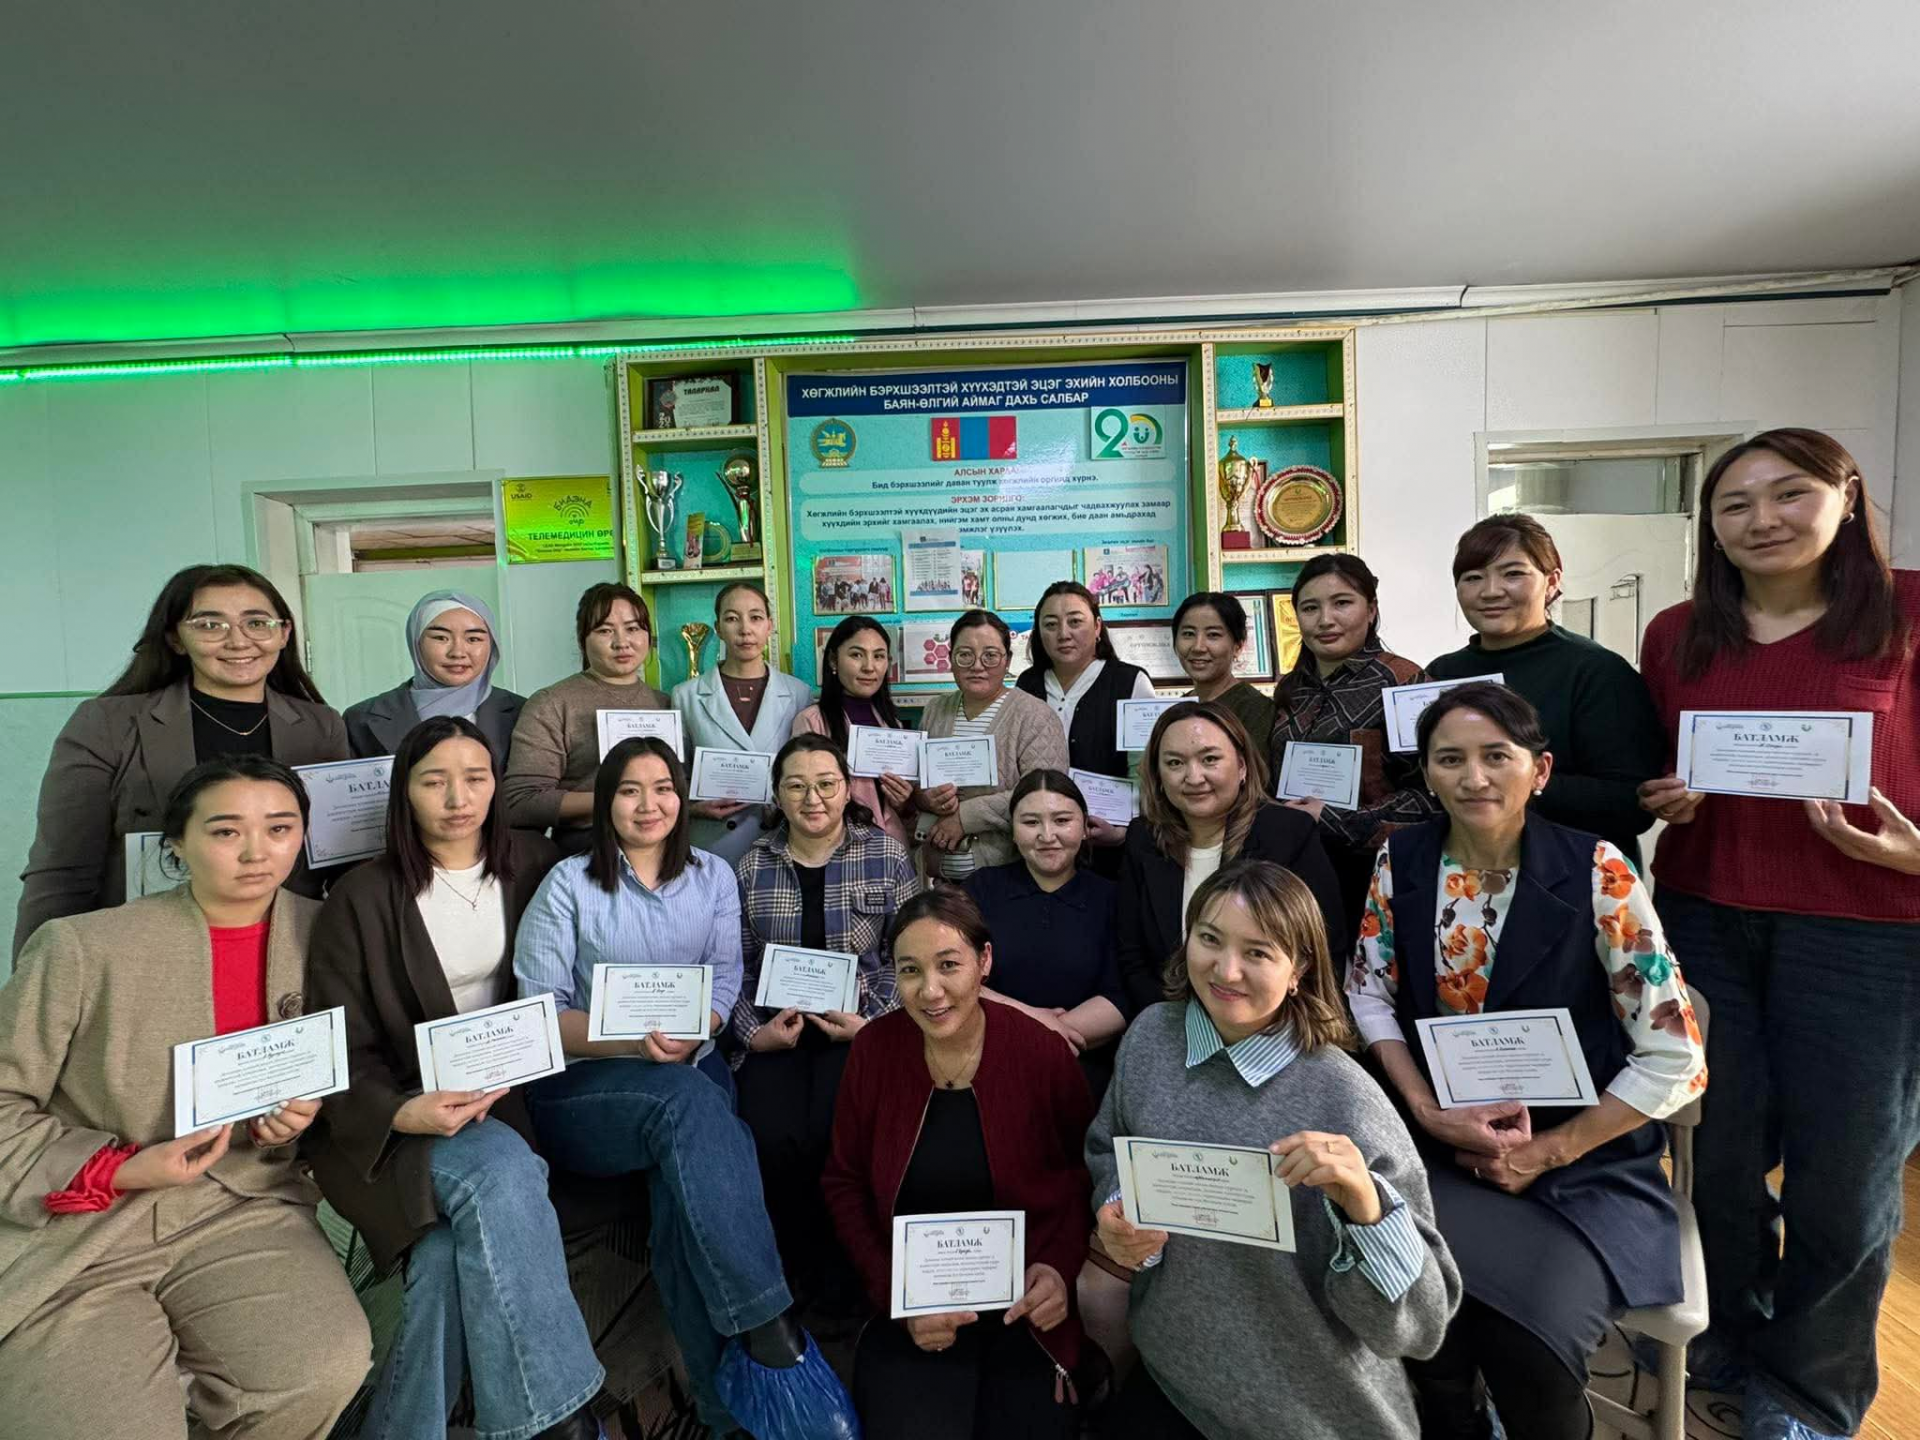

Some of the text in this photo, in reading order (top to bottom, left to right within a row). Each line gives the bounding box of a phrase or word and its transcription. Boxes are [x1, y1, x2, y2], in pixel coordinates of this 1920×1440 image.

[801, 375, 1179, 399] ХӨГЖЛИЙН БЭРХШЭЭЛТЭЙ ХҮҮХЭДТЭЙ ЭЦЭГ ЭХИЙН ХОЛБООНЫ
[884, 392, 1089, 410] БАЯН-ӨЛГИЙ АЙМАГ ДАХЬ САЛБАР
[954, 468, 986, 477] АЛСЫН
[872, 481, 889, 489] Бид
[951, 496, 980, 504] ЭРХЭМ
[528, 530, 595, 541] ТЕЛЕМЕДИЦИН
[1733, 733, 1800, 743] БАТЛАМЖ
[348, 780, 390, 793] БАТЛА
[466, 1026, 514, 1043] БАТЛАМЖ
[1471, 1036, 1526, 1048] БАТЛАМЖ
[237, 1039, 296, 1060] БАТЛАМЖ
[1171, 1163, 1230, 1177] БАТЛАМЖ
[937, 1238, 983, 1248] БАТЛАМЖ
